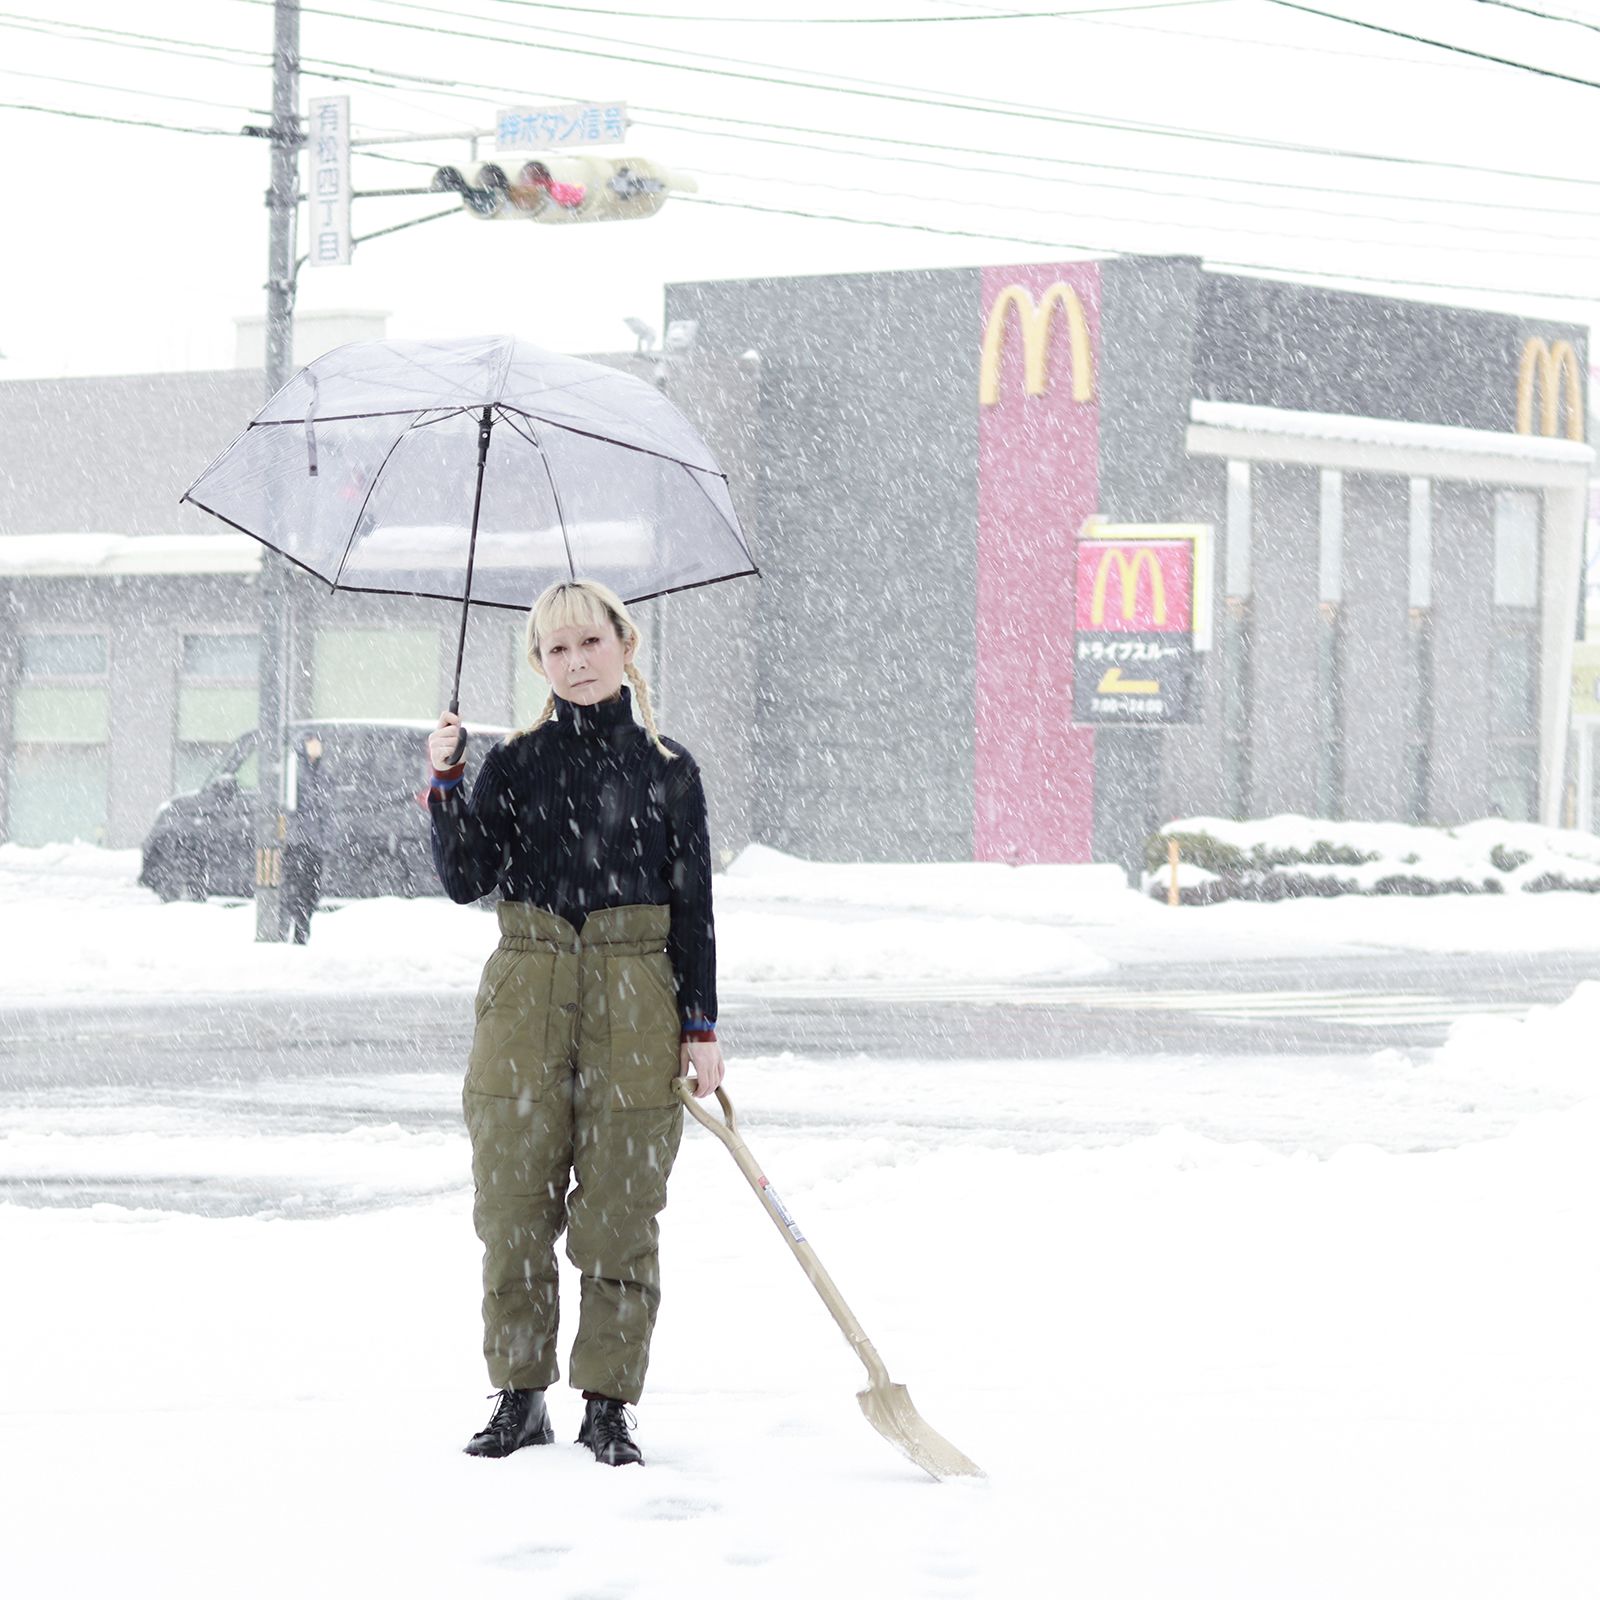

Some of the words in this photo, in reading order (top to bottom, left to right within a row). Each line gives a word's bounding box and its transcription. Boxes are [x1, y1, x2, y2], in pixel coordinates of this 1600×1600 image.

[498, 107, 624, 144] 押ボタン信号
[317, 104, 340, 261] 有松四丁目
[1077, 641, 1178, 661] ドライブスルー
